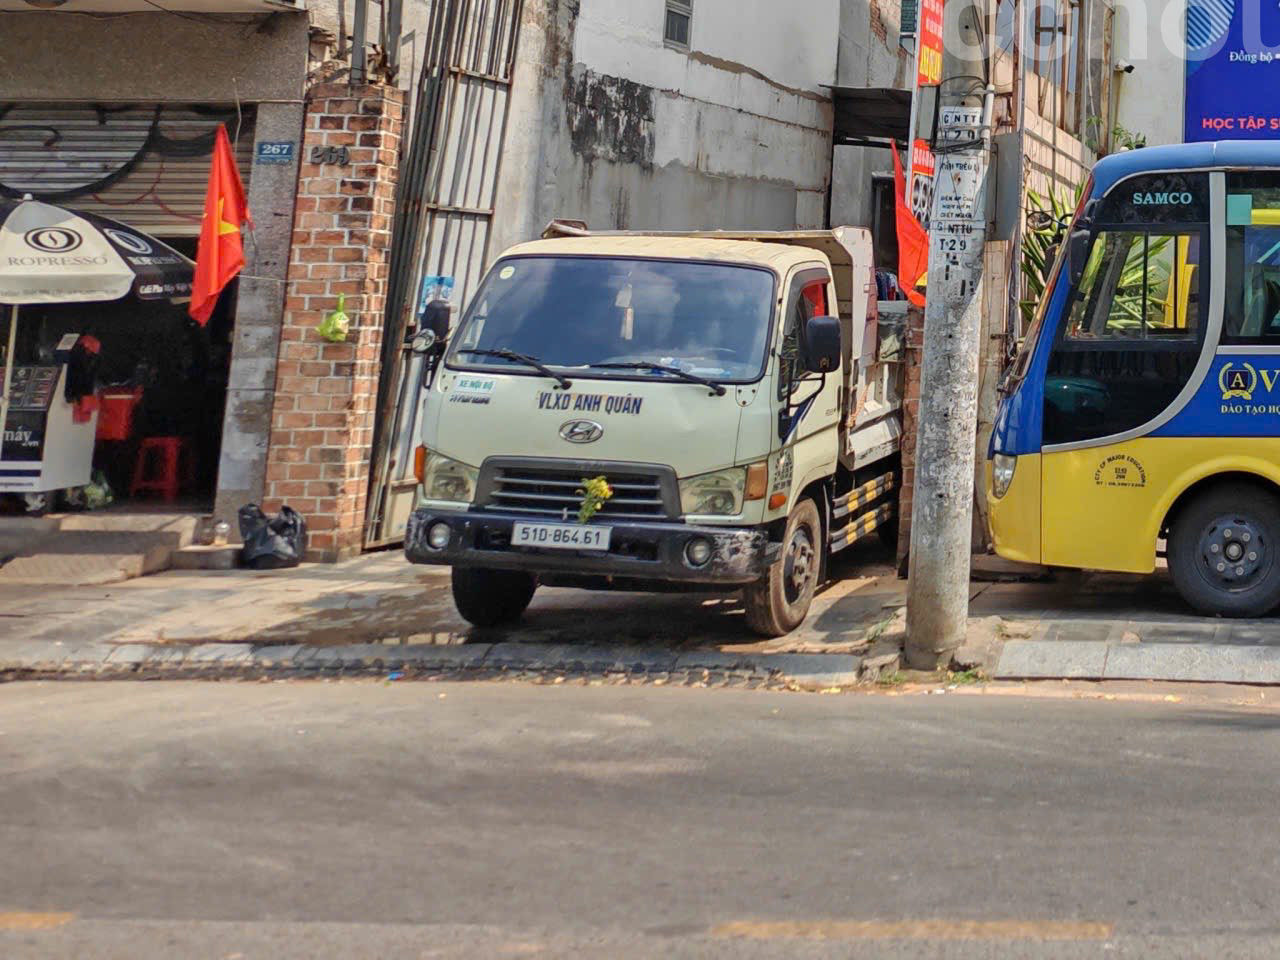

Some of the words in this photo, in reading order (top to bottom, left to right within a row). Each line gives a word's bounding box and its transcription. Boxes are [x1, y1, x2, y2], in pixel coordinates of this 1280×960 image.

[1229, 50, 1257, 64] Đồng
[1259, 51, 1273, 63] bộ
[1202, 118, 1234, 131] HỌC
[1238, 116, 1266, 131] TẬP
[262, 144, 290, 154] 267
[1133, 192, 1192, 205] SAMCO
[948, 224, 972, 234] NTTU
[1230, 372, 1246, 388] A
[538, 392, 570, 411] VLXD
[573, 394, 601, 412] ANH
[604, 393, 643, 415] QUÂN
[1221, 403, 1243, 414] ĐÀO
[1245, 405, 1266, 416] TẠO
